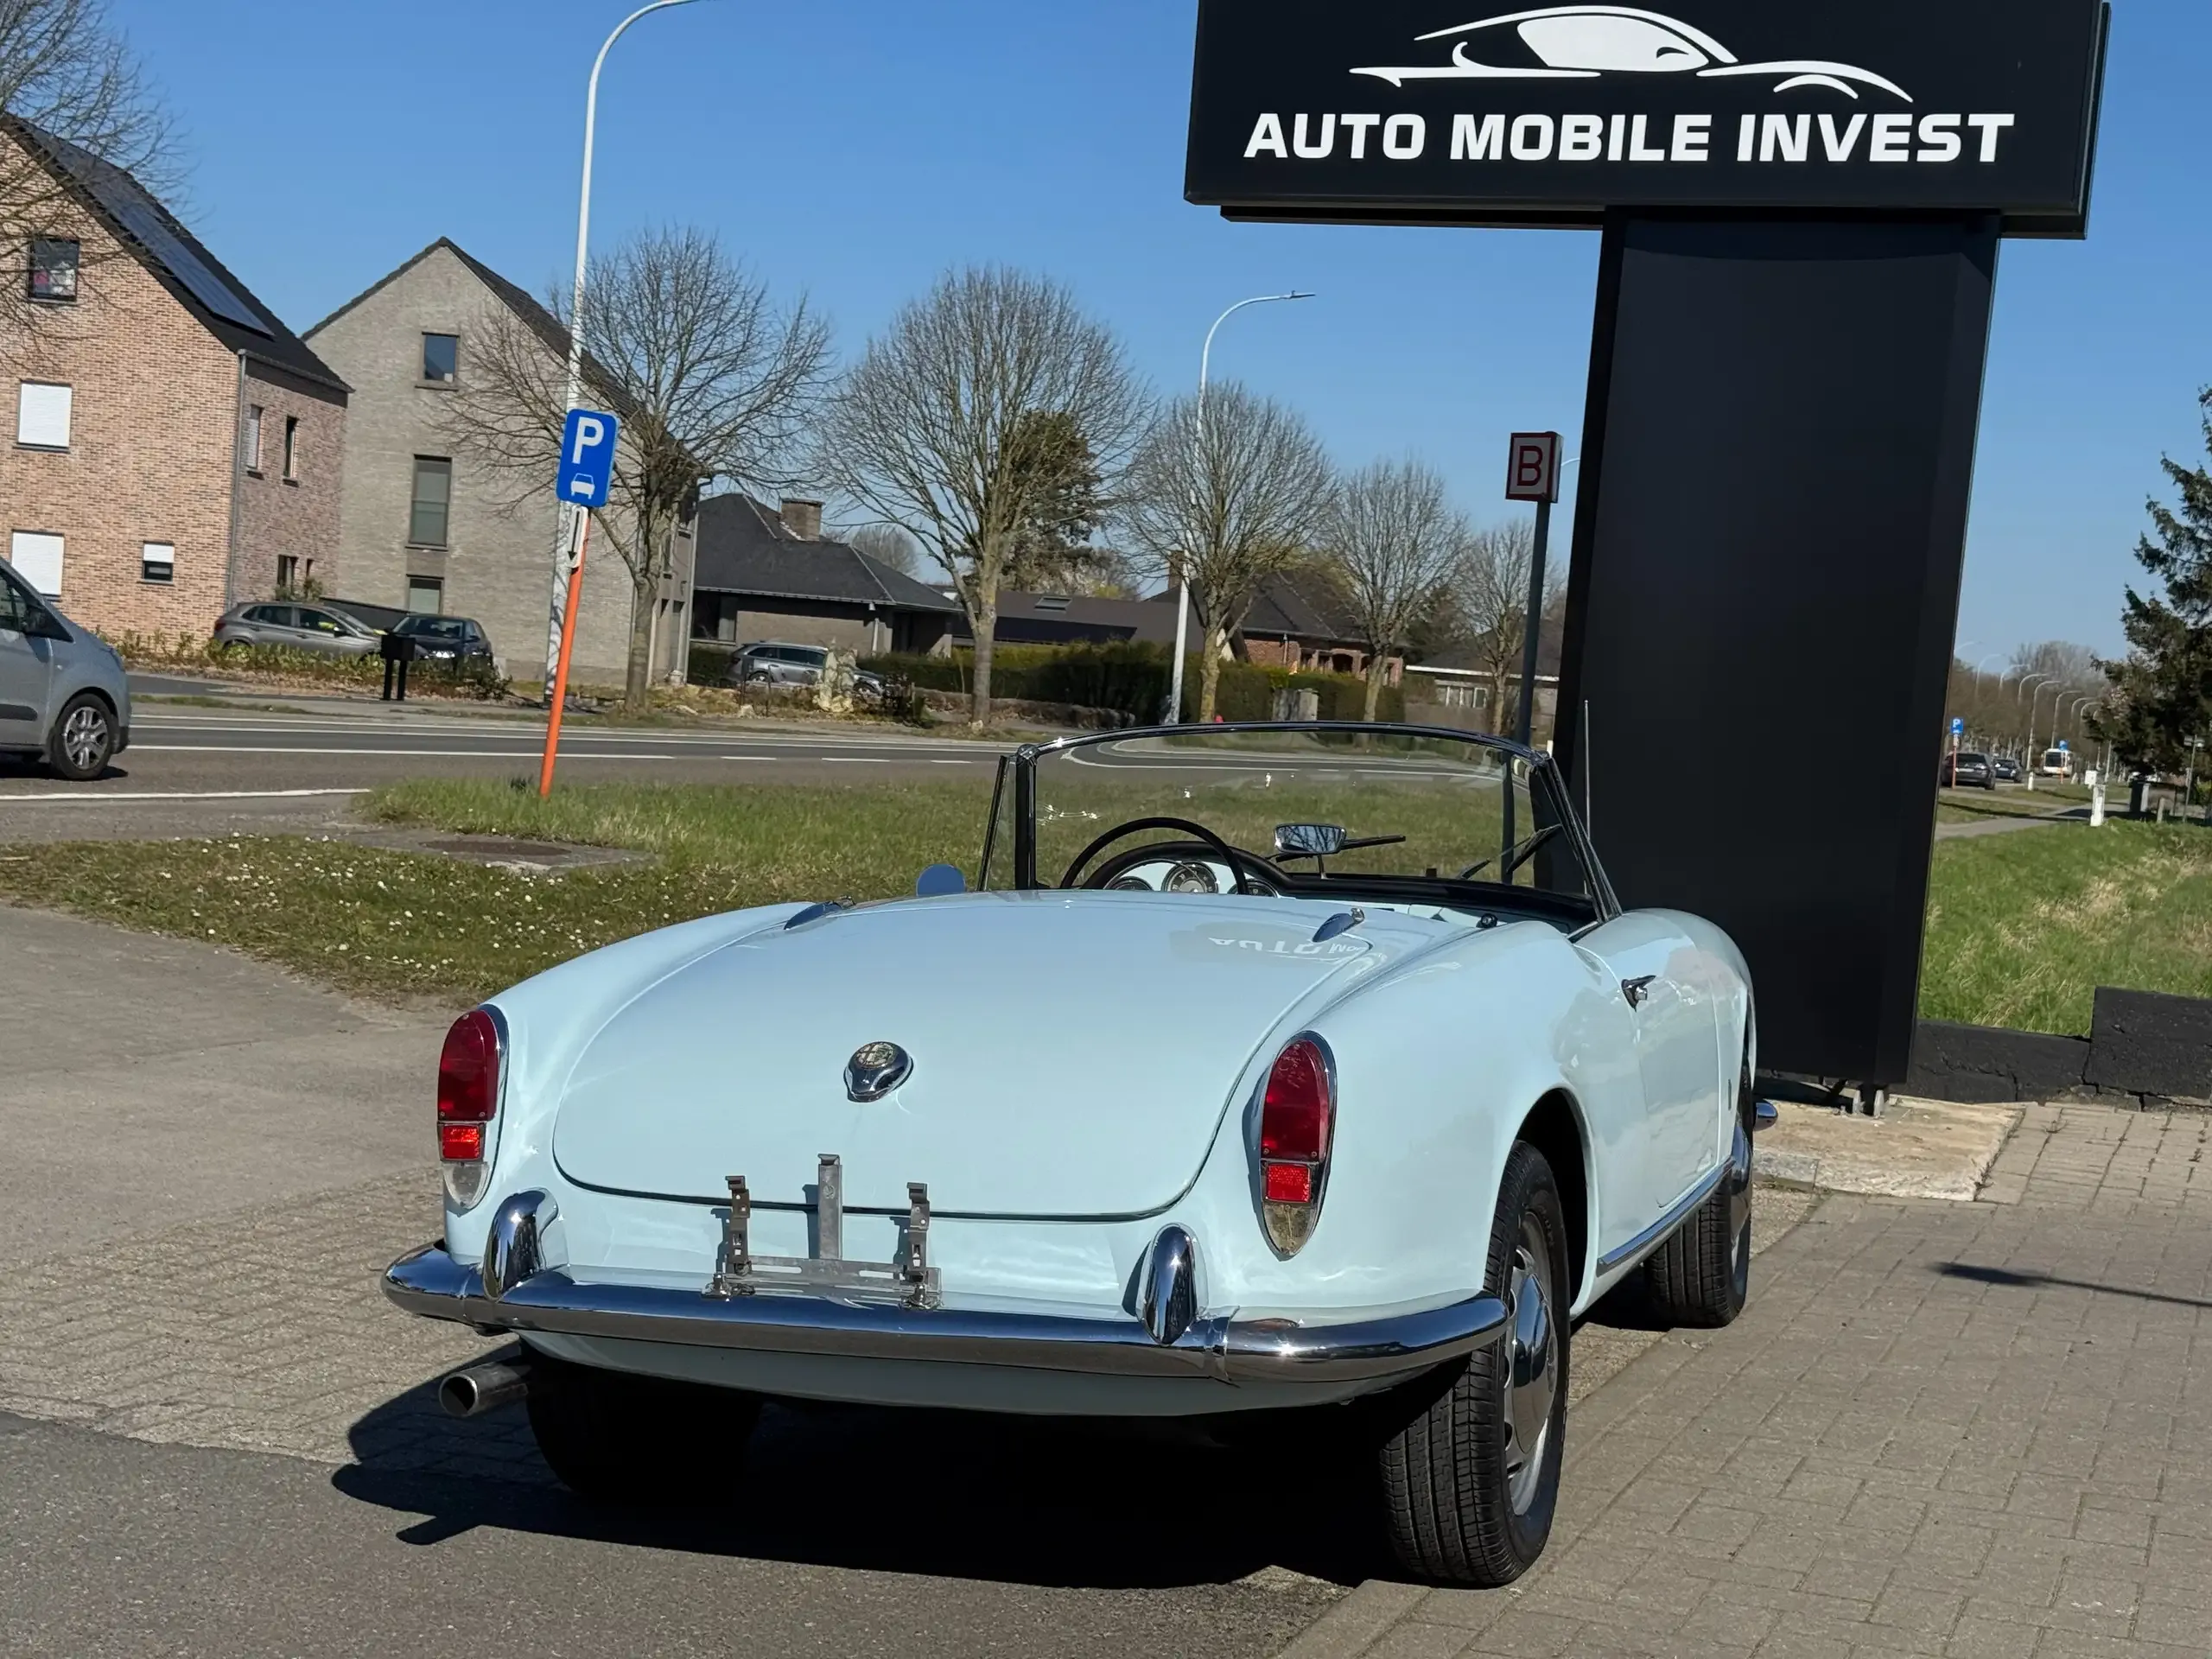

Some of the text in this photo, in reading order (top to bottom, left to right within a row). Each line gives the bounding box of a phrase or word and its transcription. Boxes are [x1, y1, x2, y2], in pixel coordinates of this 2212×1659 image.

[1243, 113, 2015, 162] AUTO MOBILE INVEST
[572, 416, 604, 464] P
[1517, 445, 1543, 486] B
[1953, 718, 1961, 728] P
